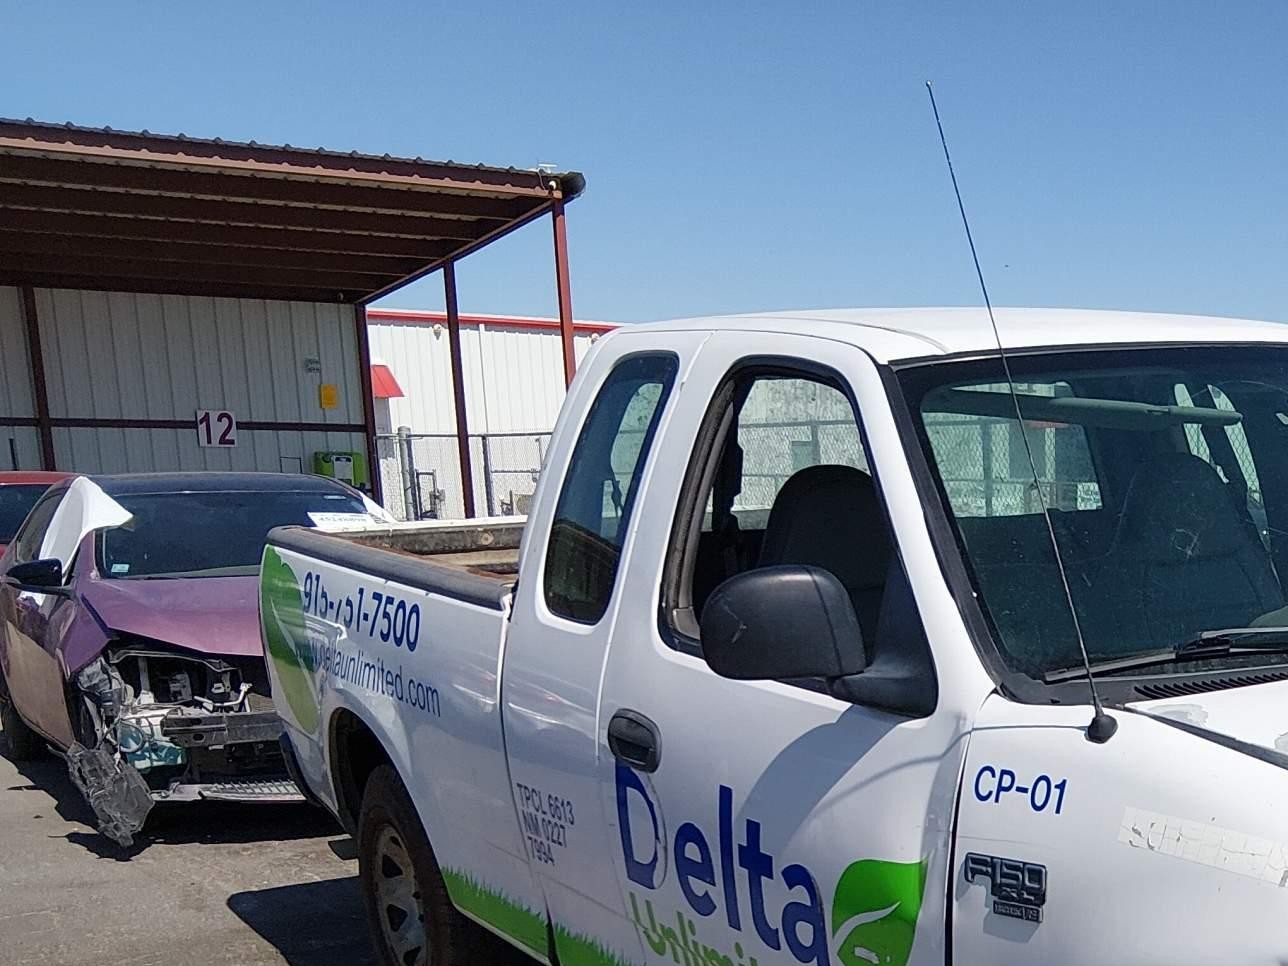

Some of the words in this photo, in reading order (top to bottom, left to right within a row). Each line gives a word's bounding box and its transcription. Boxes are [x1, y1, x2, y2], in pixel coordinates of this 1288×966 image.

[199, 412, 236, 445] 12
[516, 782, 547, 815] TPCL
[547, 794, 575, 825] 6613
[974, 765, 1067, 814] CP-01
[522, 810, 541, 838] NM
[541, 817, 567, 848] 0227
